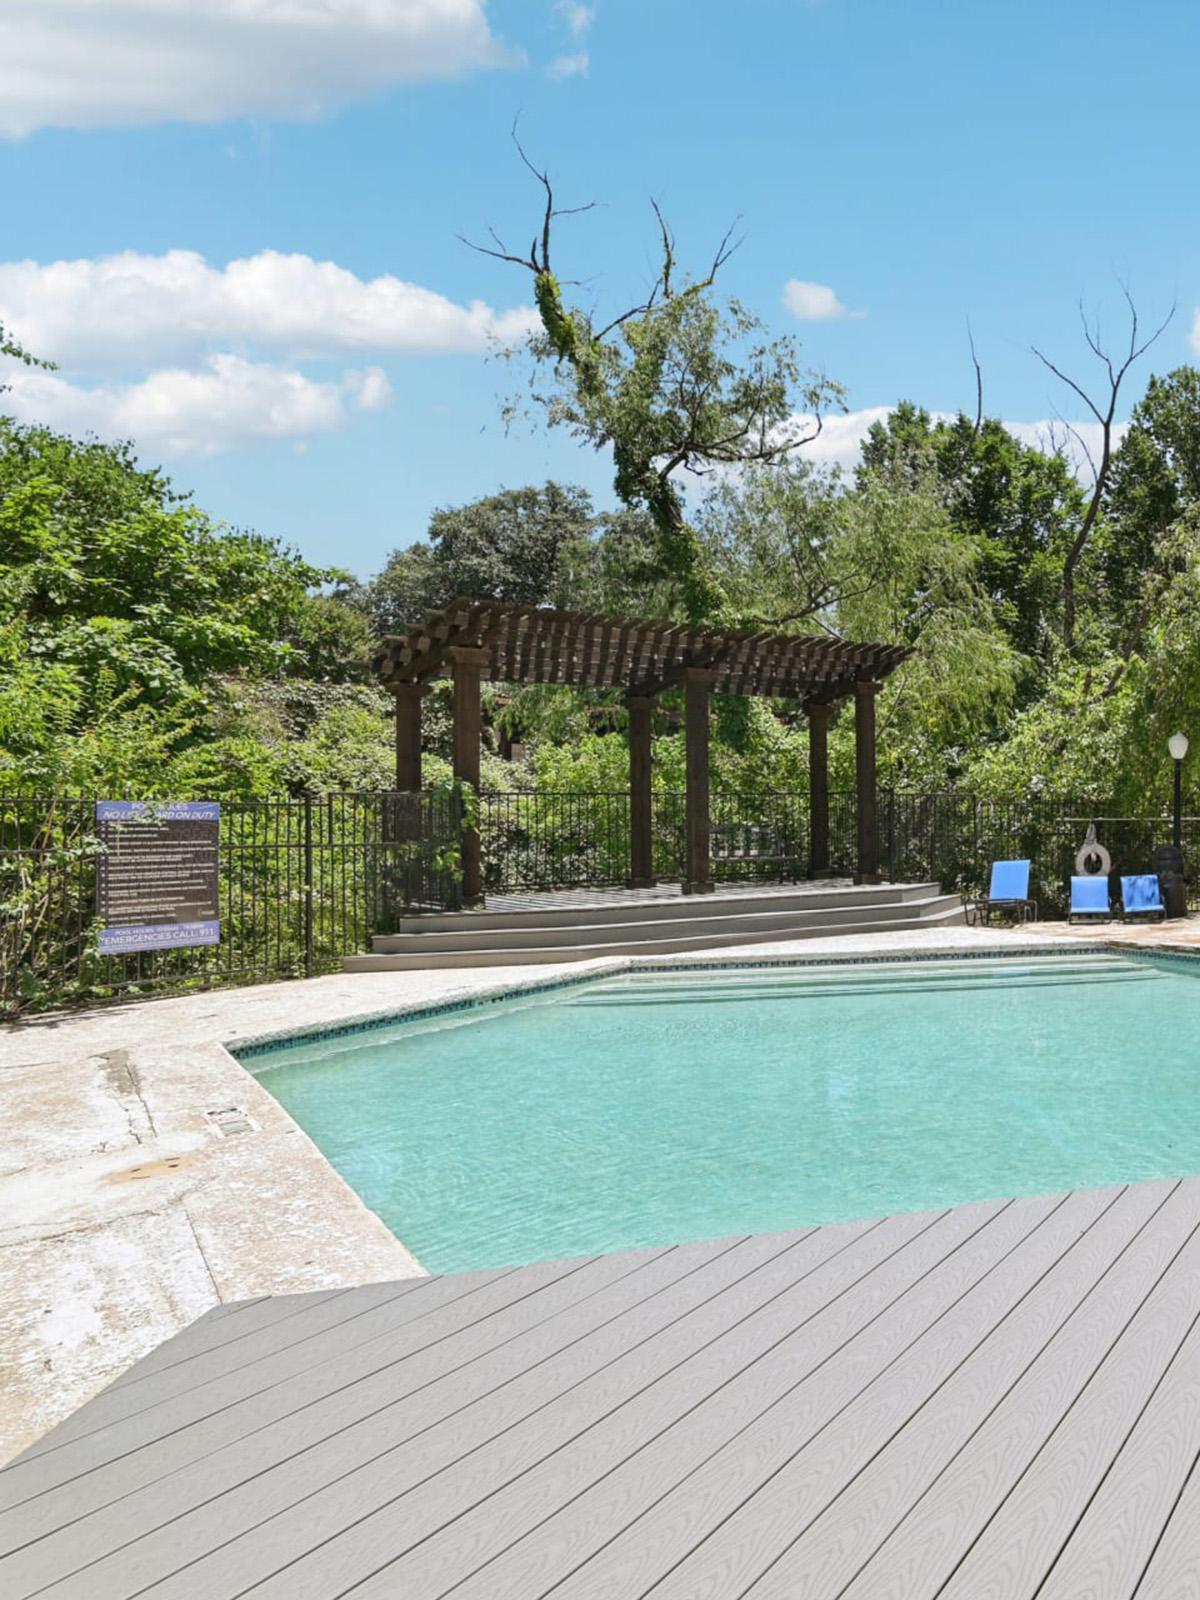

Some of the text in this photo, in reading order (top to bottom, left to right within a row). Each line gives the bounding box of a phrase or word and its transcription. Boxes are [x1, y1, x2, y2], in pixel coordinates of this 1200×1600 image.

[103, 810, 120, 819] NO
[176, 810, 190, 819] ON
[191, 810, 214, 820] DUTY
[104, 931, 171, 945] EMERGENCIES
[173, 929, 195, 940] CALL
[200, 926, 214, 937] 911
